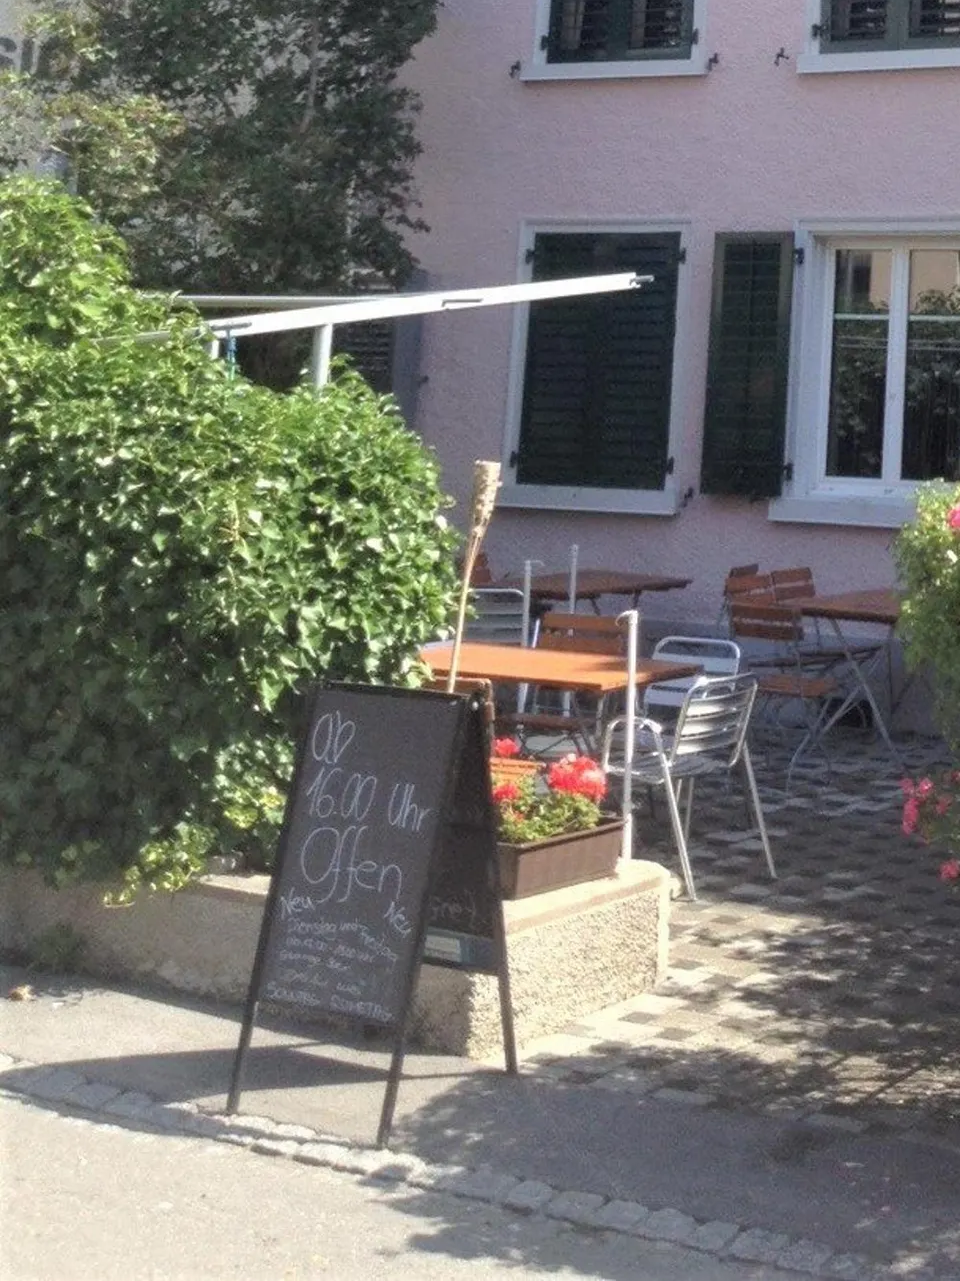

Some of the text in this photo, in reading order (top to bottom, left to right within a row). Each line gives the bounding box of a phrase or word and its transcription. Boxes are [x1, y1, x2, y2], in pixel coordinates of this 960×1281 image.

[306, 767, 432, 832] 16.00 Uhr
[301, 825, 403, 904] Offen
